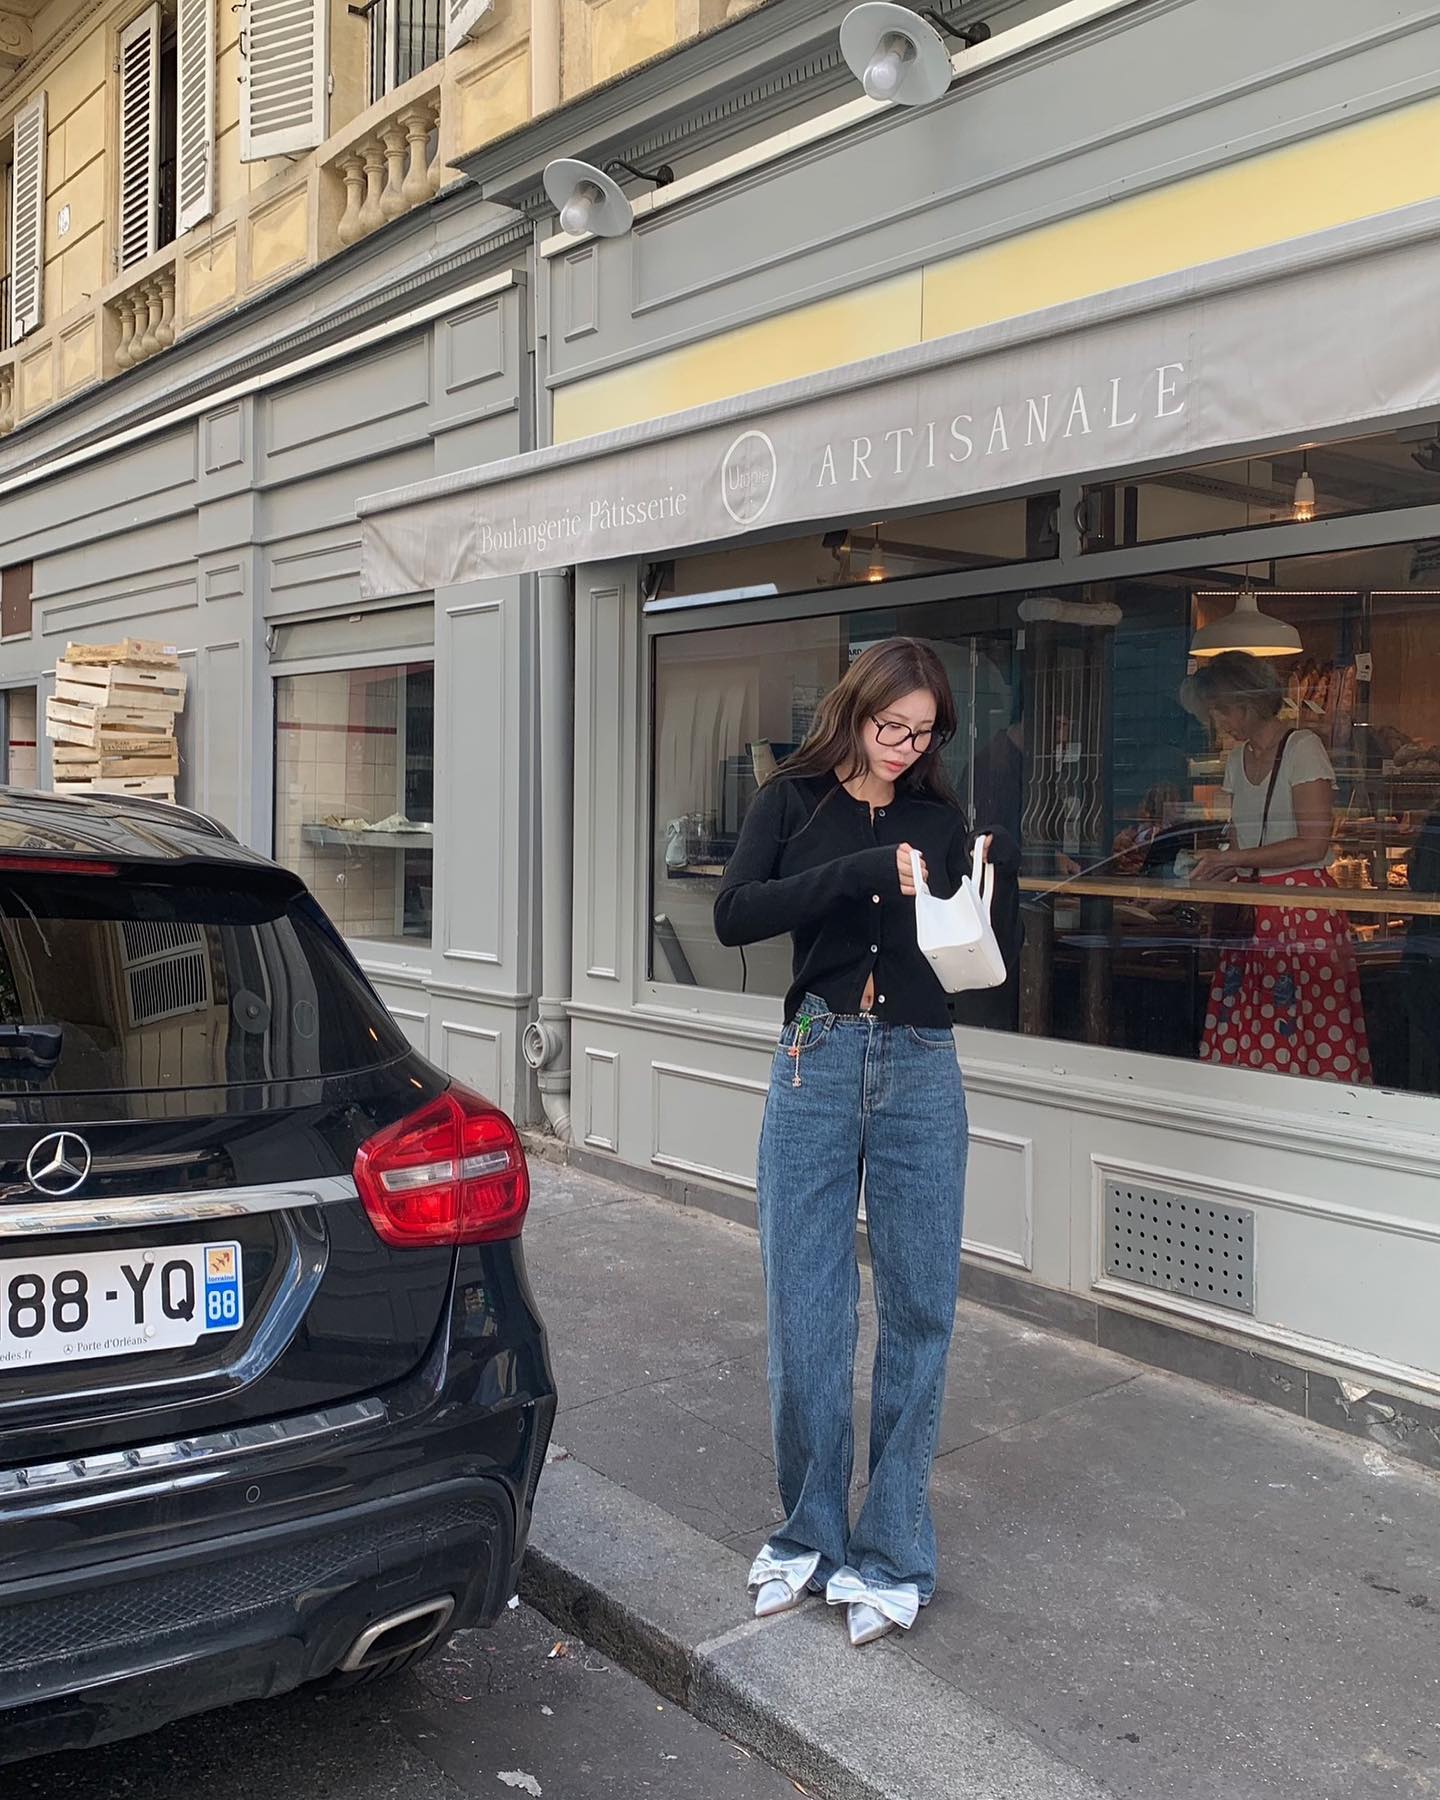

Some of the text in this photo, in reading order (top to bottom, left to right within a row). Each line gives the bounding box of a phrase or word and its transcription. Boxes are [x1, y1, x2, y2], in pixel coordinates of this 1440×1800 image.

[816, 362, 1185, 488] ARTISANALE
[481, 486, 687, 553] Boulangerie Pâtisserie
[0, 1259, 195, 1338] 88-YQ
[208, 1289, 236, 1320] 88
[77, 1336, 148, 1352] Porte d'Orléans
